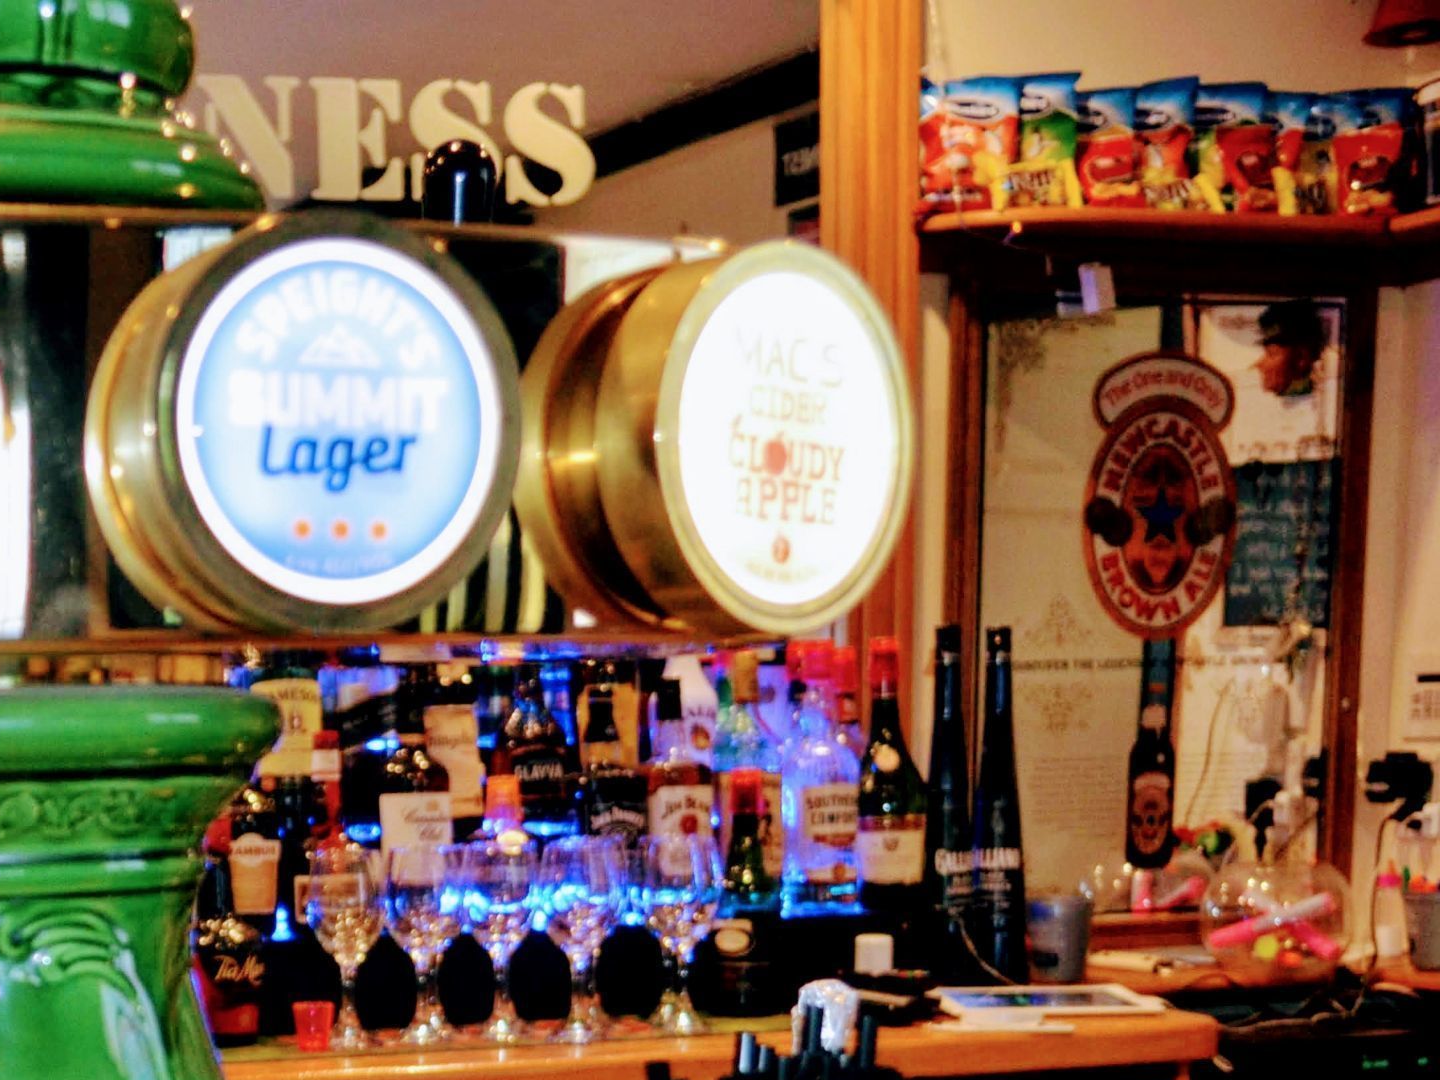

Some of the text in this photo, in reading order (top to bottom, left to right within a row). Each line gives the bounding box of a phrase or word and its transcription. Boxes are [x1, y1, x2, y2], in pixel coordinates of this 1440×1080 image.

[735, 325, 843, 388] MACS
[227, 368, 450, 435] SUMMIT
[260, 426, 418, 493] Lager
[1103, 416, 1220, 492] NEWCASTLE
[735, 477, 838, 525] APPLE
